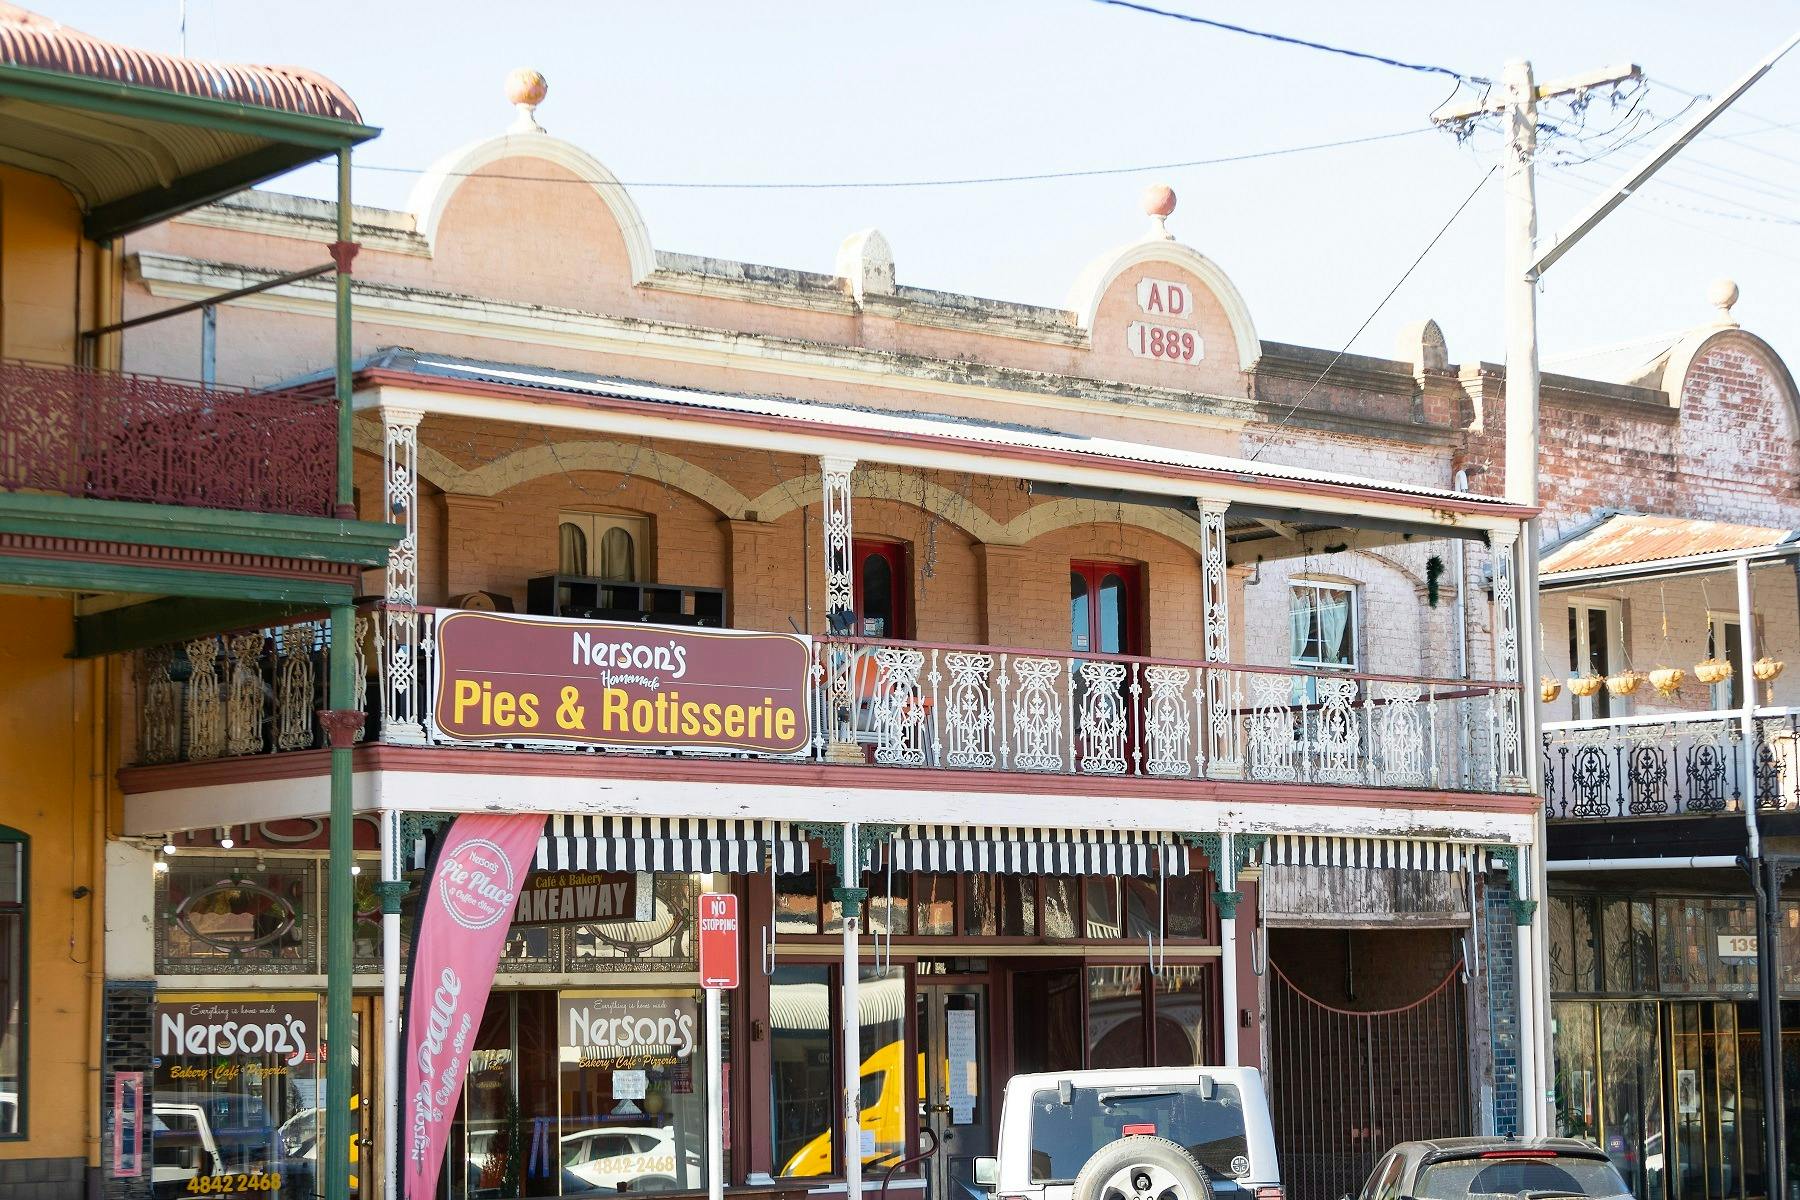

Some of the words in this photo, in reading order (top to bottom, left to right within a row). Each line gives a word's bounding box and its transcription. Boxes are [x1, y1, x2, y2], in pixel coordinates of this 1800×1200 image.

[1148, 283, 1184, 314] AD
[1140, 326, 1195, 360] 1889
[573, 631, 687, 679] Nerson's
[600, 669, 660, 691] Homemade
[454, 679, 540, 728] Pies
[555, 686, 586, 731] &
[603, 688, 797, 740] Rotisserie
[469, 851, 499, 875] Nerson's
[440, 858, 468, 884] Pie
[467, 871, 514, 906] Place
[535, 876, 556, 889] Café
[560, 875, 567, 887] &
[569, 873, 603, 887] Bakery
[455, 889, 478, 906] Coffee
[478, 900, 496, 914] Shop
[511, 882, 628, 922] AKEAWAY
[711, 900, 727, 915] NO
[702, 918, 736, 931] STOPPING
[190, 1003, 230, 1020] Everything
[241, 1004, 258, 1014] home
[260, 1004, 277, 1014] made
[593, 1000, 627, 1015] Everything
[636, 1000, 650, 1009] home
[652, 1000, 667, 1009] made
[161, 1012, 306, 1067] Nerson's
[454, 1012, 472, 1054] Shop
[569, 1007, 693, 1058] Nerson's
[170, 1065, 209, 1080] Bakery
[214, 1065, 240, 1081] Café
[245, 1065, 288, 1079] Pizzeria
[579, 1056, 610, 1070] Bakery
[615, 1055, 638, 1070] Café
[643, 1055, 678, 1069] Pizzeria
[435, 1056, 460, 1106] Coffee
[433, 1107, 444, 1122] &
[593, 1157, 631, 1174] 4842
[636, 1156, 674, 1172] 2468
[187, 1175, 233, 1193] 4842
[237, 1172, 281, 1191] 2468
